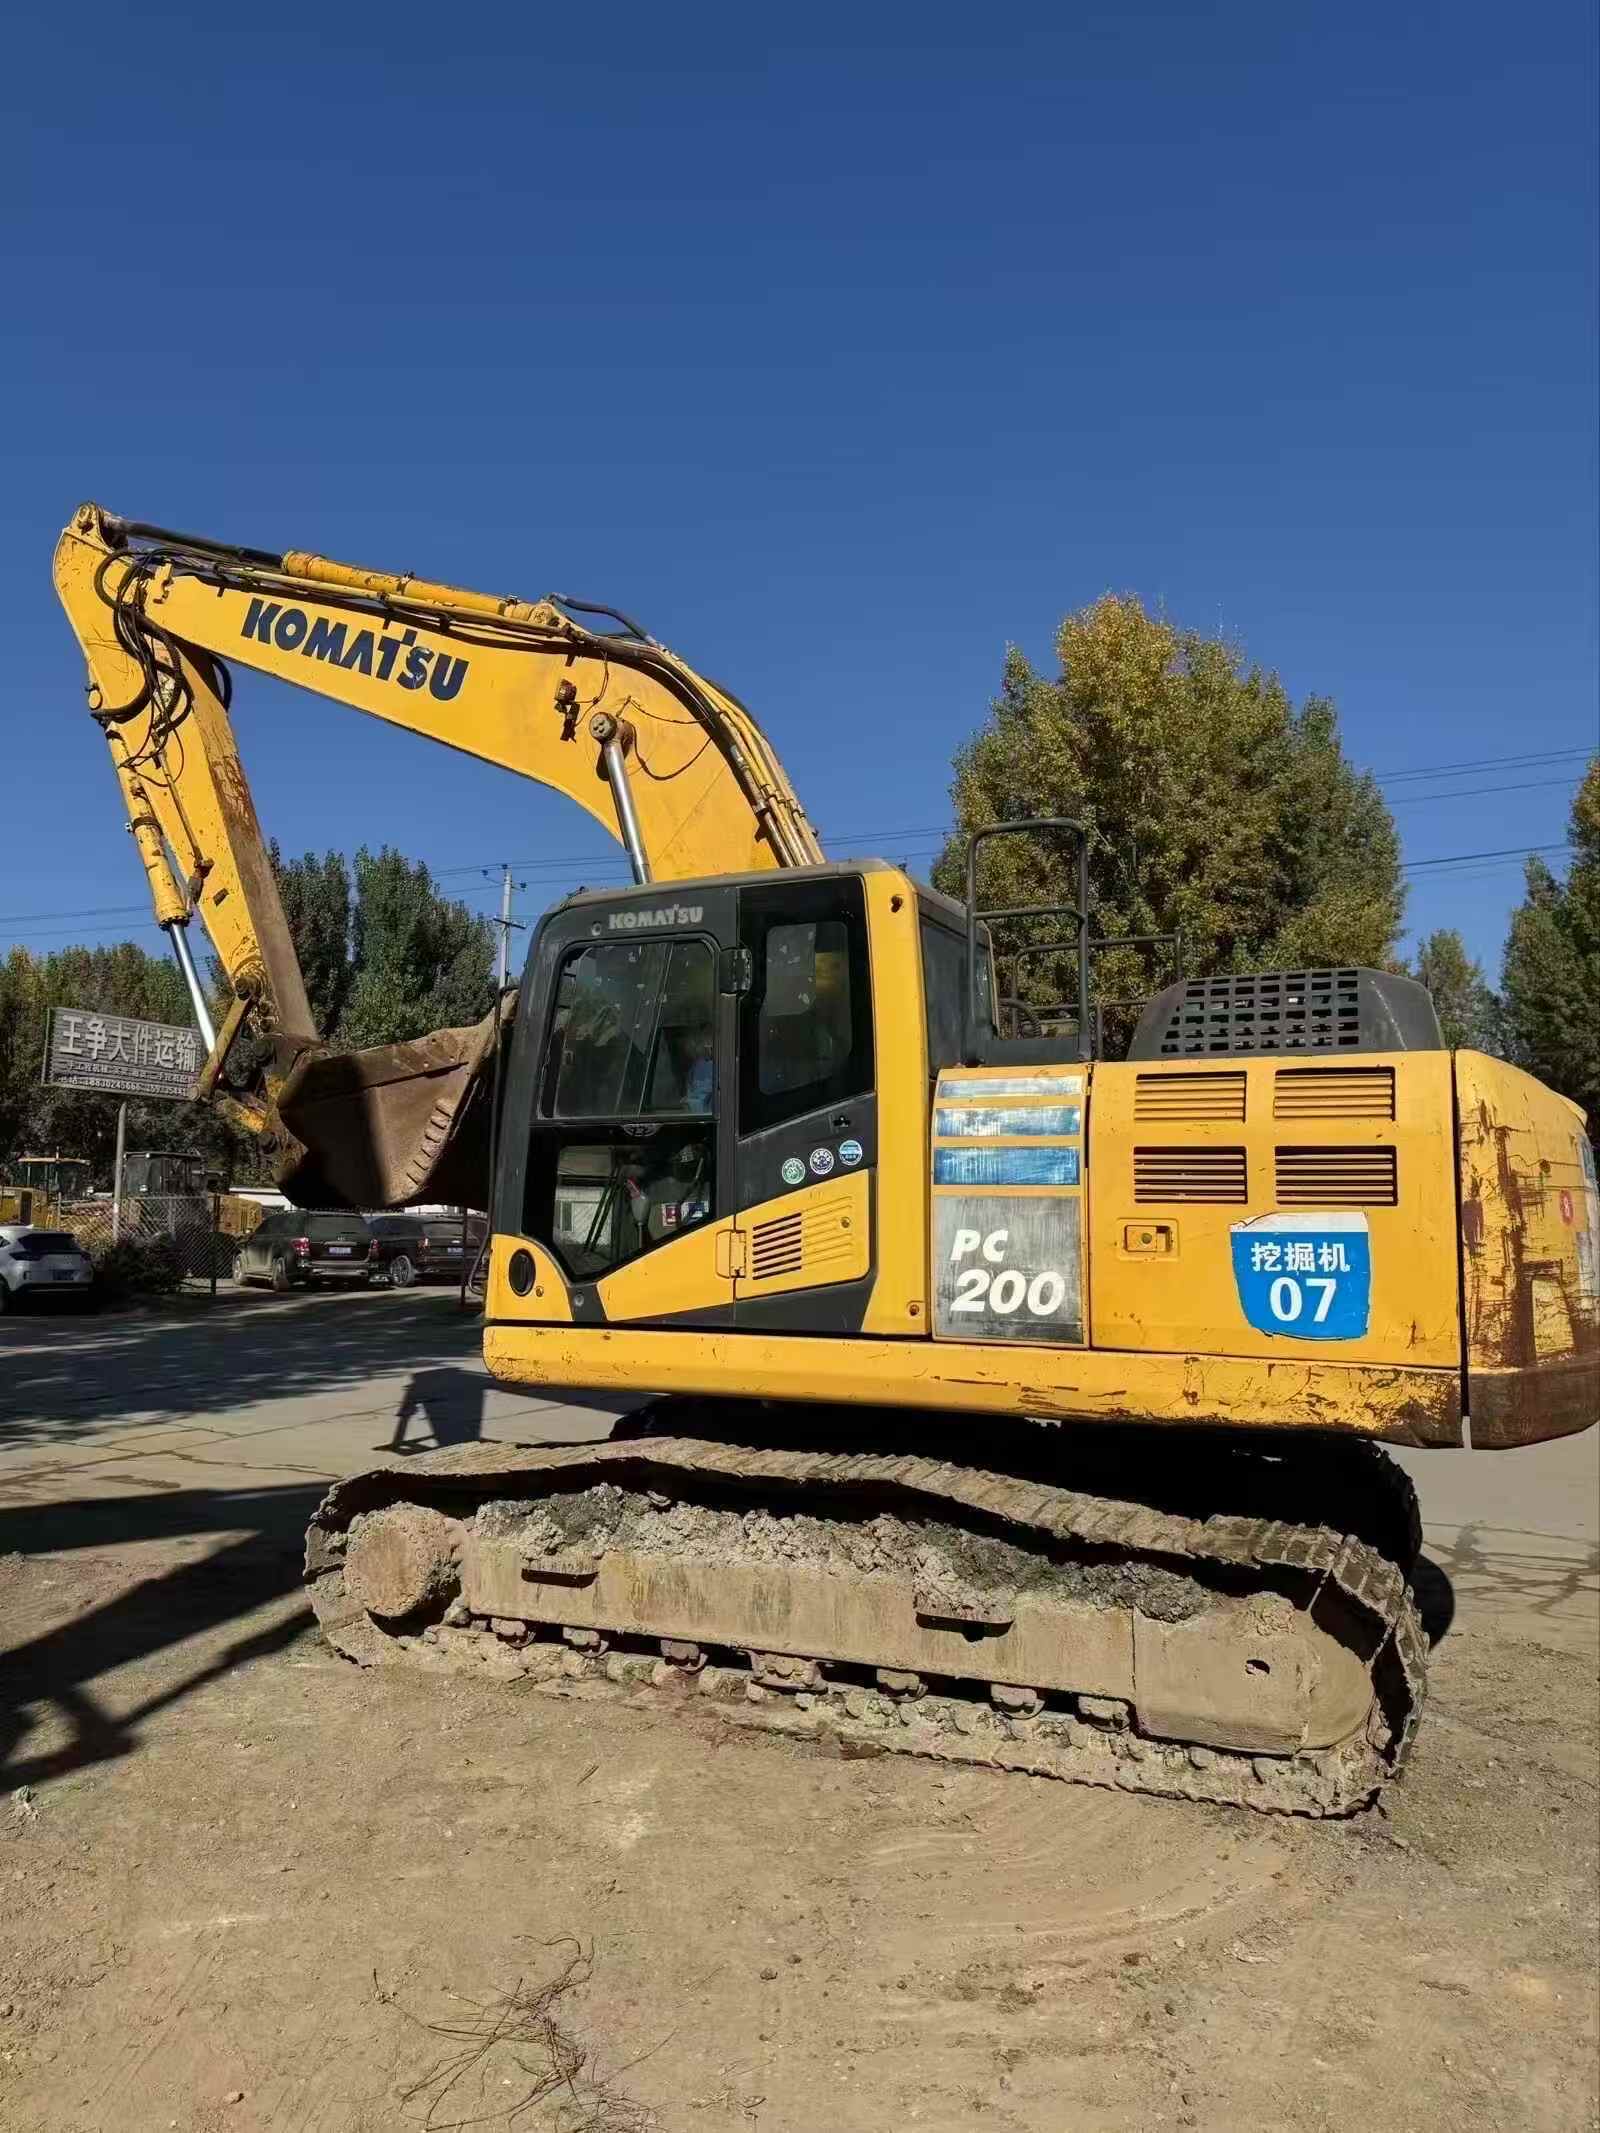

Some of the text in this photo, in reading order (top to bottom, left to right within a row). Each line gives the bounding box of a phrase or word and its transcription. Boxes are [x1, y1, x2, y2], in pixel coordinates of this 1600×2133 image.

[240, 597, 470, 701] KOMATSU
[609, 904, 704, 930] KOMATSU
[59, 1015, 197, 1073] 王争大件运输
[950, 1229, 1009, 1262] PC
[1250, 1241, 1351, 1273] 挖掘机
[950, 1268, 1066, 1316] 200
[1269, 1276, 1337, 1323] 07
